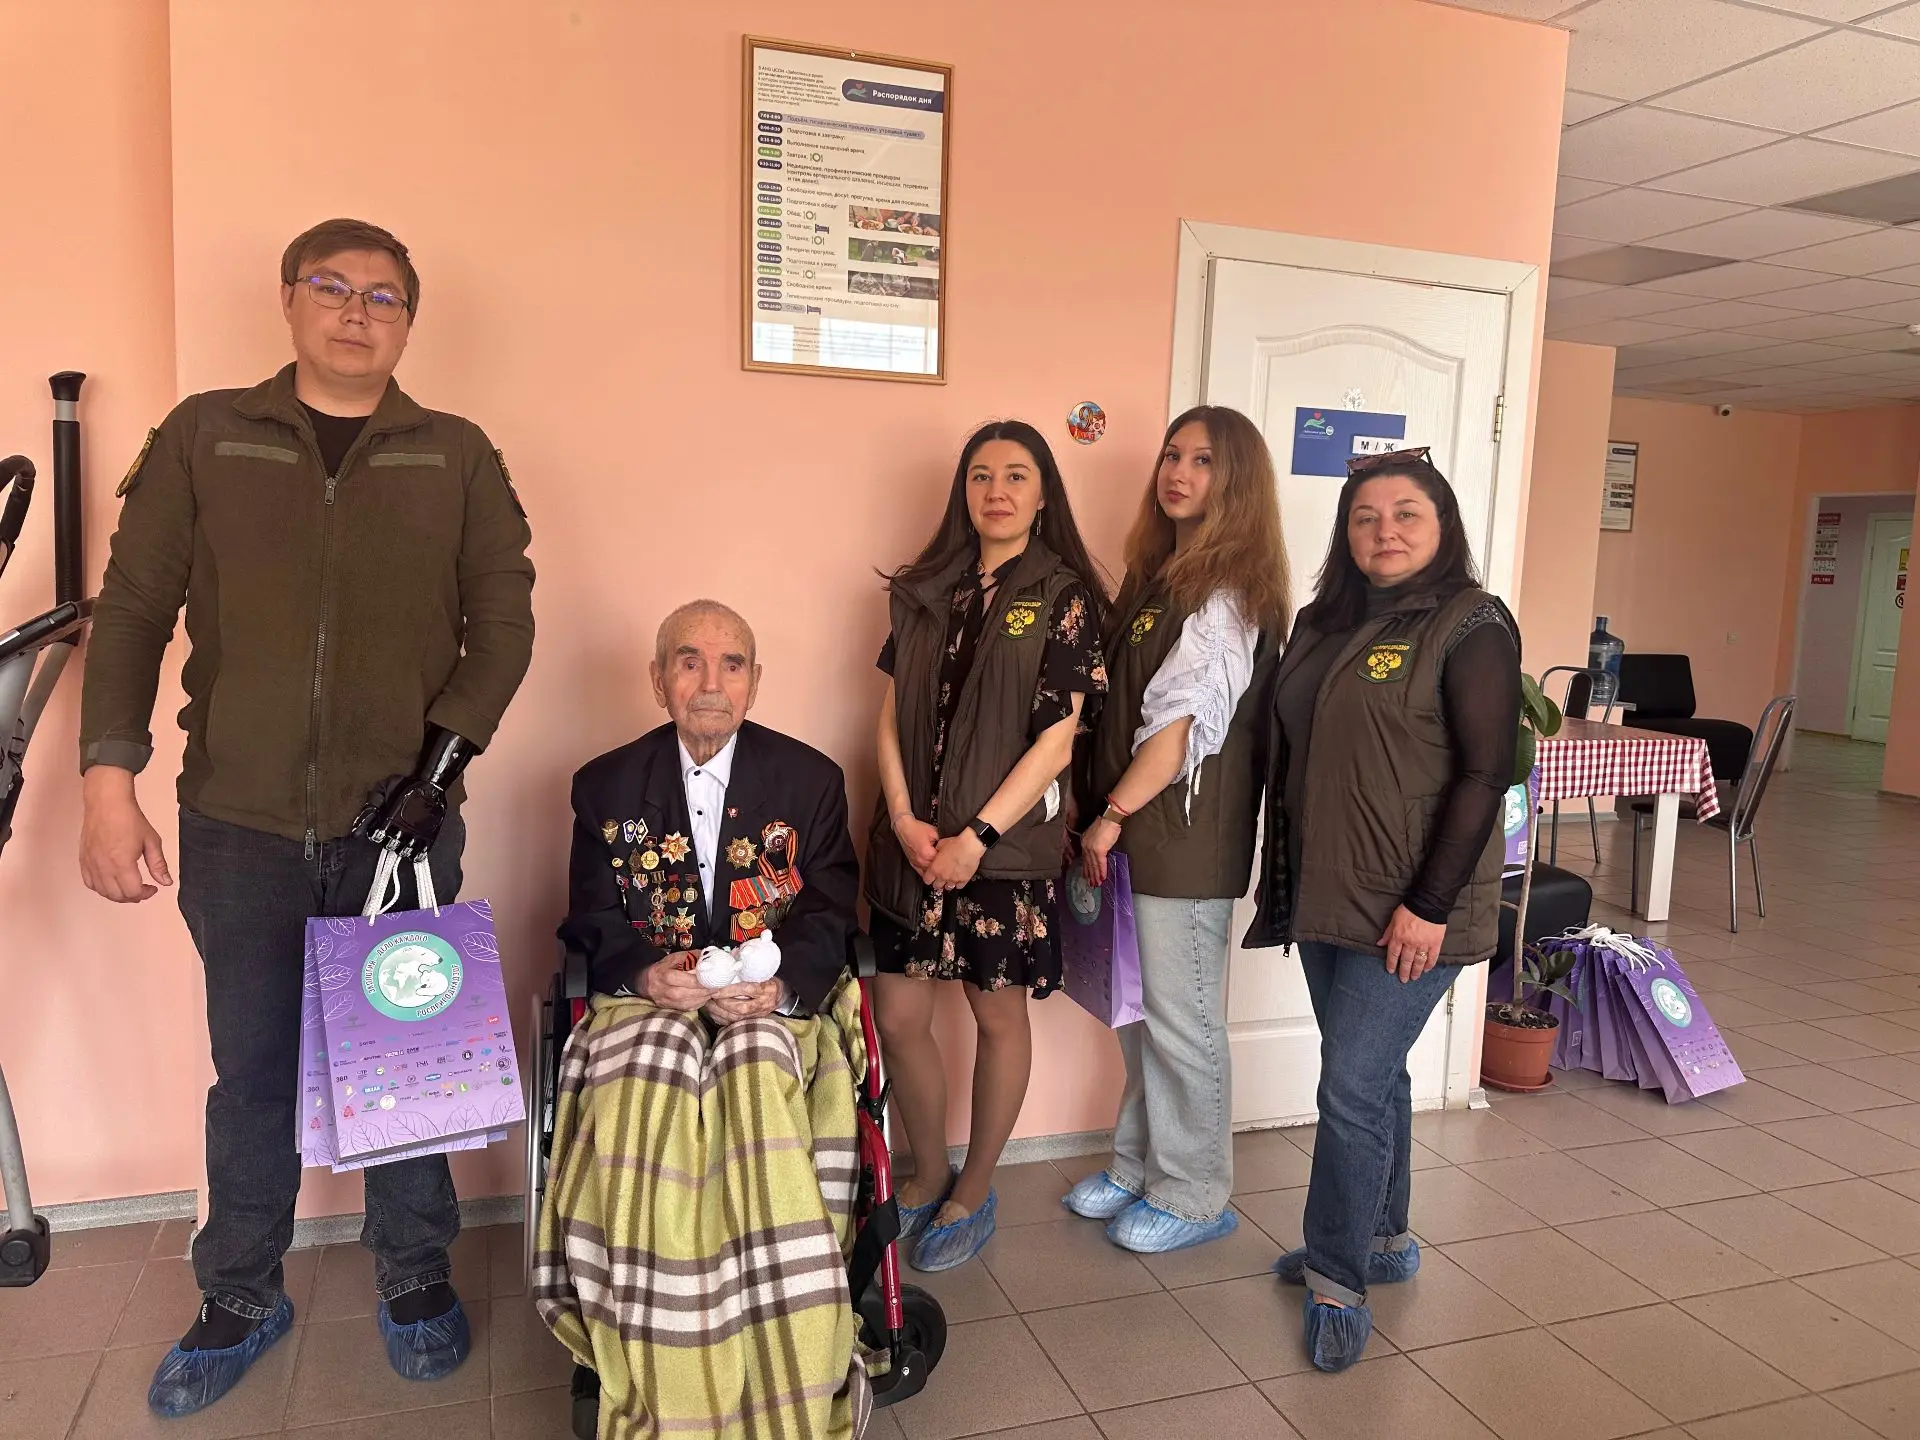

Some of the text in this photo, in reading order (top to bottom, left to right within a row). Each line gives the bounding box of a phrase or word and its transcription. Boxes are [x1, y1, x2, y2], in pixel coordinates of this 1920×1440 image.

[872, 90, 917, 102] Распорядок
[1361, 441, 1370, 450] М
[1384, 442, 1394, 451] Ж
[377, 941, 394, 956] ДЕЛО
[394, 934, 428, 946] КАЖДОГО
[416, 963, 461, 1018] РОСПРИРОДНАДЗОР
